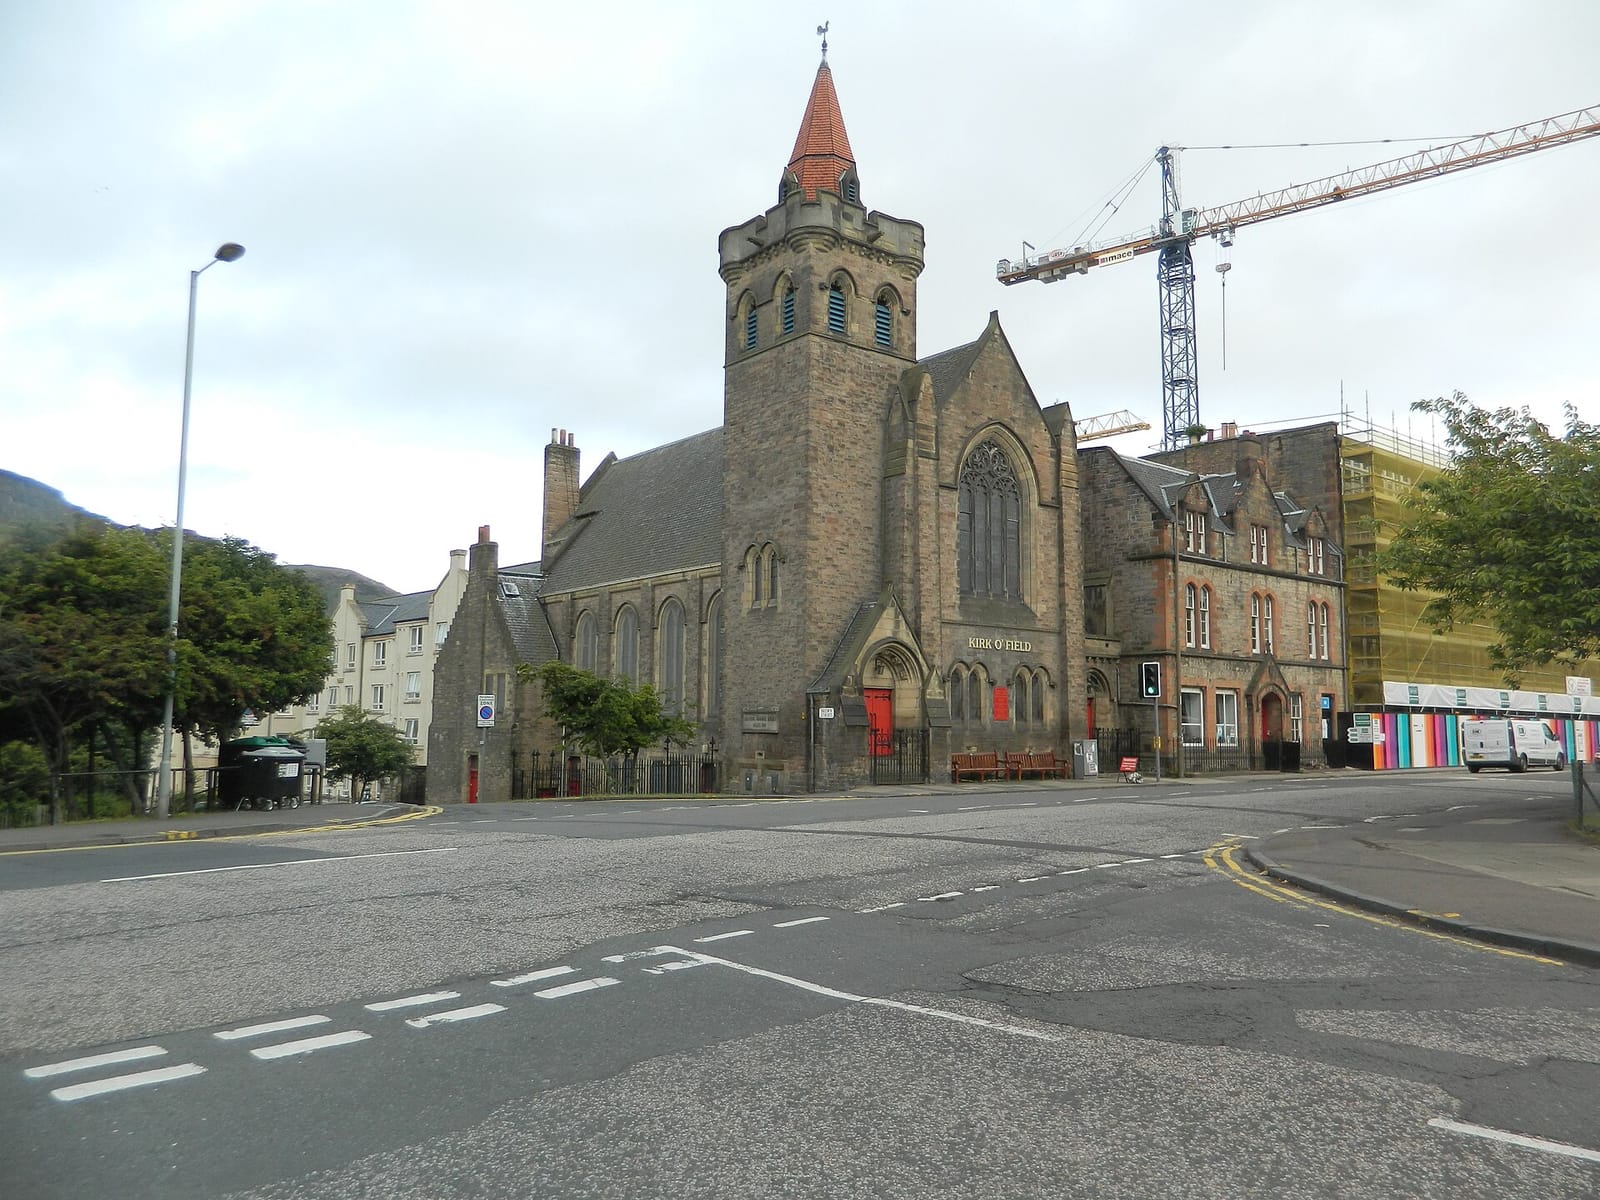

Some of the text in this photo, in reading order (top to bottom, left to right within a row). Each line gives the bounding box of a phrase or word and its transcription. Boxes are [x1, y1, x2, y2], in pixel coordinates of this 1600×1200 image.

[968, 637, 1032, 651] KIRK O' FIELD
